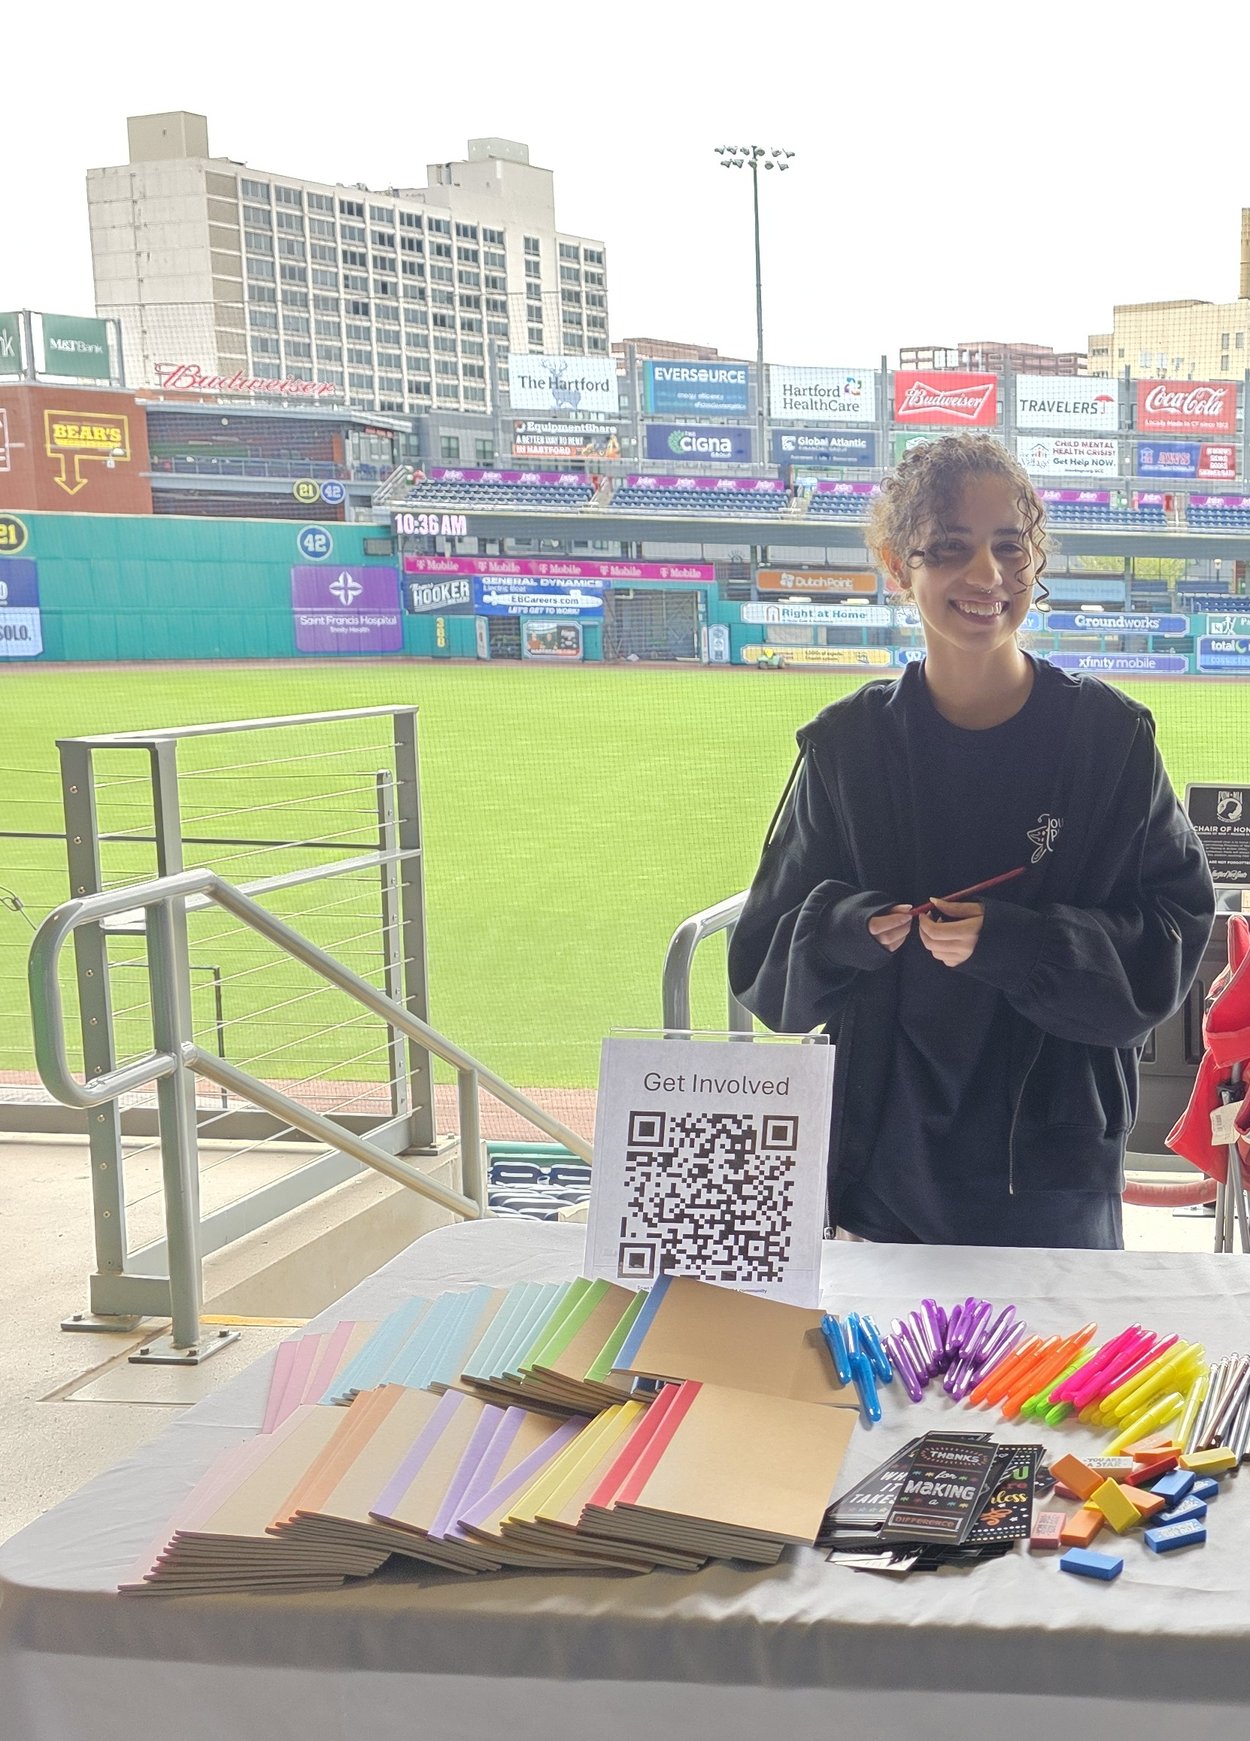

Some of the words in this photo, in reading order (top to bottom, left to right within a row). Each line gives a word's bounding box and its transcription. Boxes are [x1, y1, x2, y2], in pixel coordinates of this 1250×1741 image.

[154, 362, 339, 397] Budweiser
[654, 367, 746, 384] EVERSOURCE
[518, 375, 546, 389] The
[548, 375, 610, 392] Hartford
[783, 384, 841, 398] Hartford
[783, 398, 860, 412] HealthCare
[905, 389, 983, 408] Budweiser
[1144, 385, 1229, 416] Coca-Cola
[1019, 399, 1098, 415] TRAVELERS
[53, 423, 122, 442] BEAR'S
[527, 421, 617, 434] EquipmentShare
[797, 436, 829, 447] Global
[830, 437, 867, 448] Atlantic
[1054, 440, 1080, 448] CHILD
[1081, 441, 1114, 449] MENTAL
[527, 446, 571, 455] HARTFORD
[1053, 447, 1085, 455] HEALTH
[1053, 457, 1068, 465] Get
[1070, 458, 1089, 467] Help
[1091, 459, 1116, 467] NOW.
[324, 485, 341, 498] 42
[394, 513, 440, 535] 10:36
[440, 514, 467, 536] AM
[303, 533, 327, 553] 42
[427, 559, 459, 571] Mobile
[489, 560, 521, 573] Mobile
[550, 562, 582, 575] Mobile
[610, 565, 641, 577] Mobile
[670, 567, 701, 578] Mobile
[482, 577, 537, 586] GENERAL
[540, 578, 603, 587] DYNAMICS
[796, 576, 853, 588] DutchPoint
[413, 580, 470, 607] HOOKER
[511, 594, 579, 605] EBCareers.com
[782, 608, 813, 618] Right
[817, 609, 830, 618] at
[832, 610, 866, 619] Home
[300, 615, 325, 625] Saint
[326, 615, 359, 625] Francis
[360, 615, 398, 627] Hospital
[1074, 615, 1158, 629] Groundworks
[1211, 640, 1236, 651] total
[1078, 656, 1115, 670] xfinity
[1116, 656, 1157, 669] mobile
[644, 1072, 686, 1092] Get
[692, 1073, 790, 1096] Involved
[934, 1470, 957, 1480] for
[880, 1483, 904, 1492] IT
